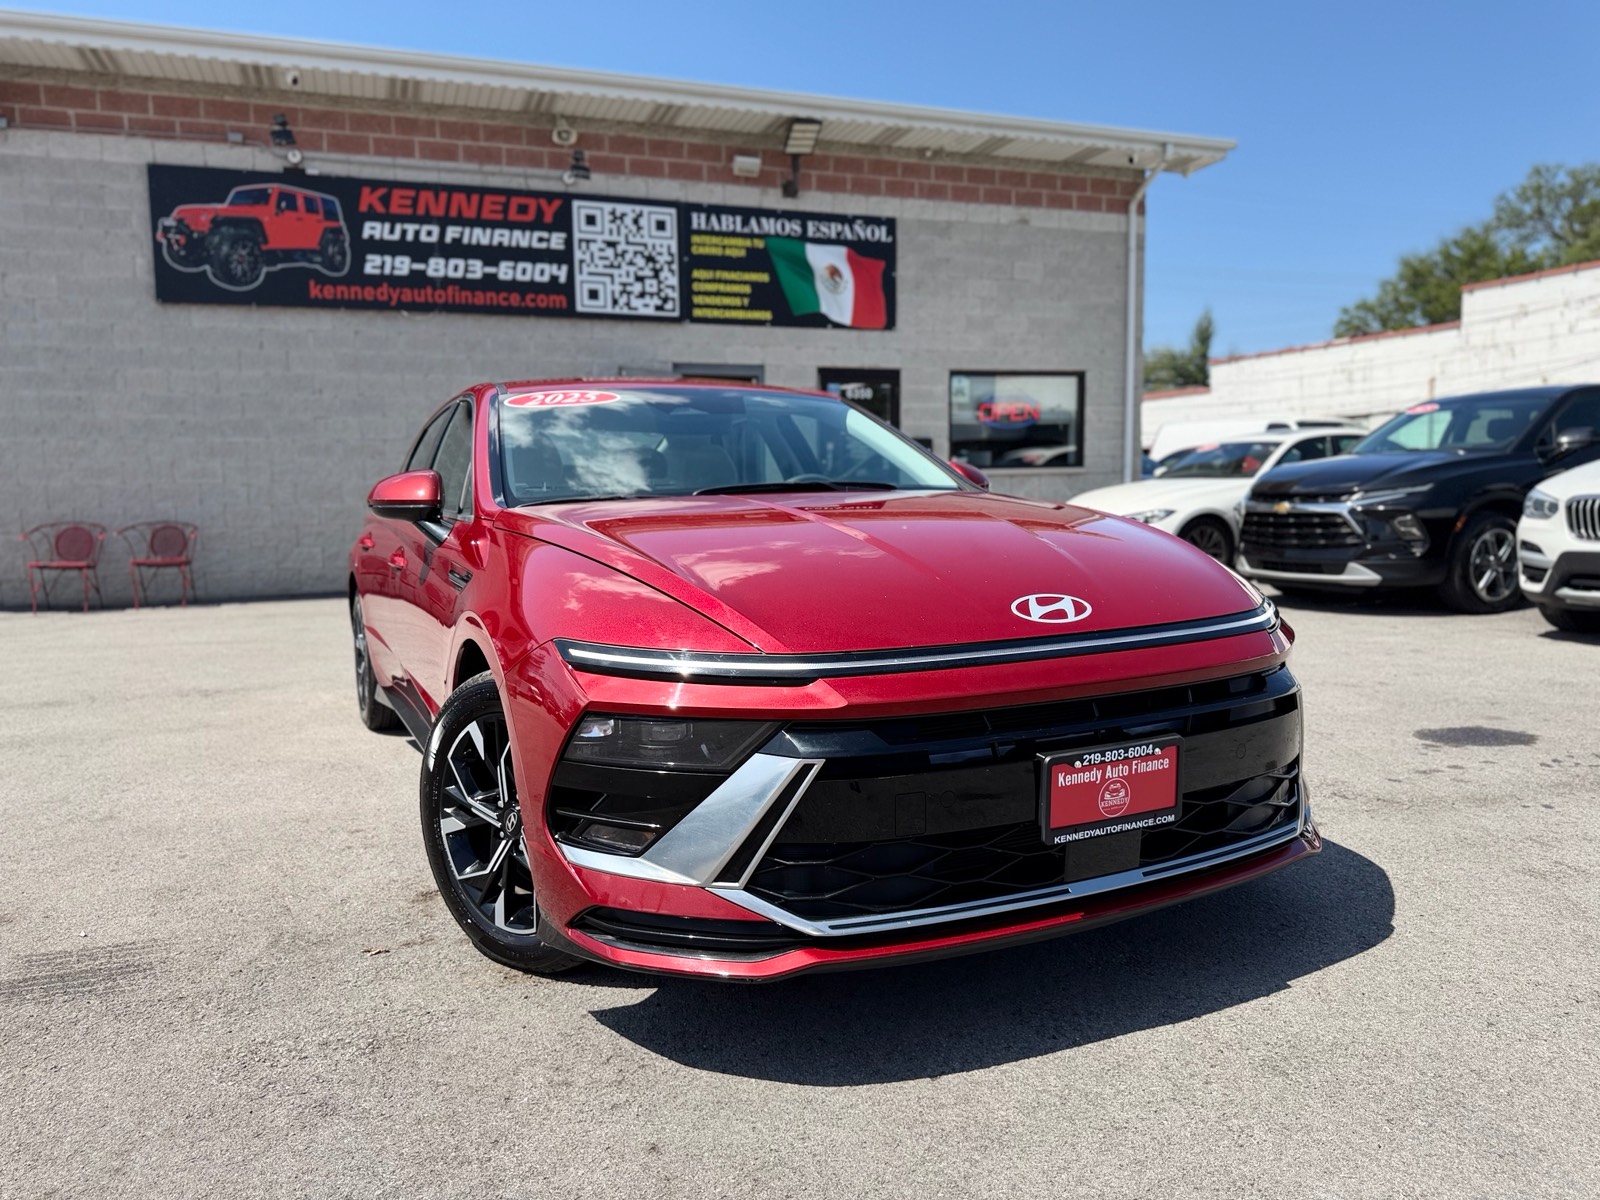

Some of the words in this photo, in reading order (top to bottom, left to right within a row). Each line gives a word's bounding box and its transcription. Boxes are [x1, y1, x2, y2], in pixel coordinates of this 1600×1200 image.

[359, 187, 562, 223] KENNEDY
[362, 221, 440, 243] AUTO
[444, 225, 567, 249] FINANCE
[690, 212, 802, 237] HABLAMOS
[806, 219, 893, 243] ESPAÑOL
[363, 254, 568, 284] 219-803-6004
[309, 280, 567, 308] kennedyautofinance.com
[523, 392, 597, 406] 2025
[976, 401, 1041, 423] OPEN
[1082, 744, 1153, 766] 219-803-6004
[1058, 767, 1102, 787] Kennedy
[1105, 762, 1129, 779] Auto
[1132, 757, 1170, 775] Finance
[1101, 797, 1128, 807] KENNEDY
[1054, 814, 1175, 844] KENNEDYAUTOFINANCE.COM
